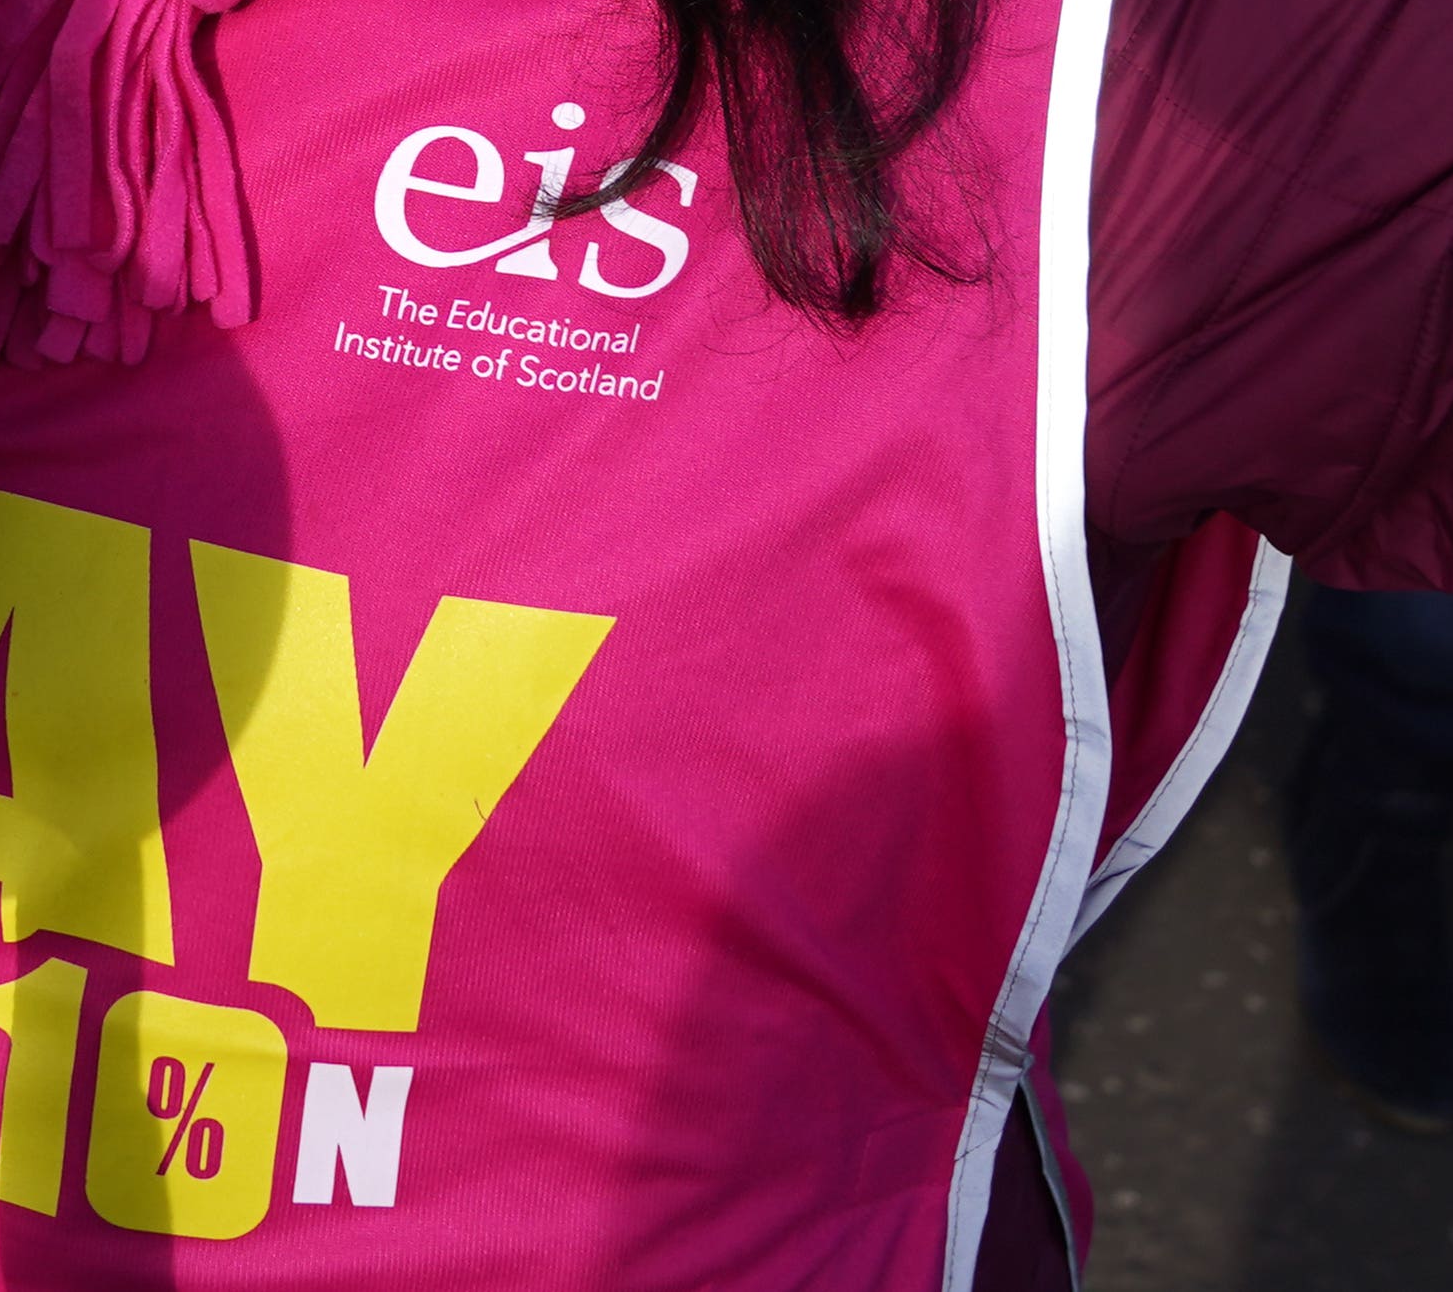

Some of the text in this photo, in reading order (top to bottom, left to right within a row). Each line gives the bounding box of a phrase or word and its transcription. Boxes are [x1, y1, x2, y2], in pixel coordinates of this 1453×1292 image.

[373, 101, 699, 299] eis
[378, 283, 641, 354] The Educational
[334, 321, 665, 401] Institute of Scotland
